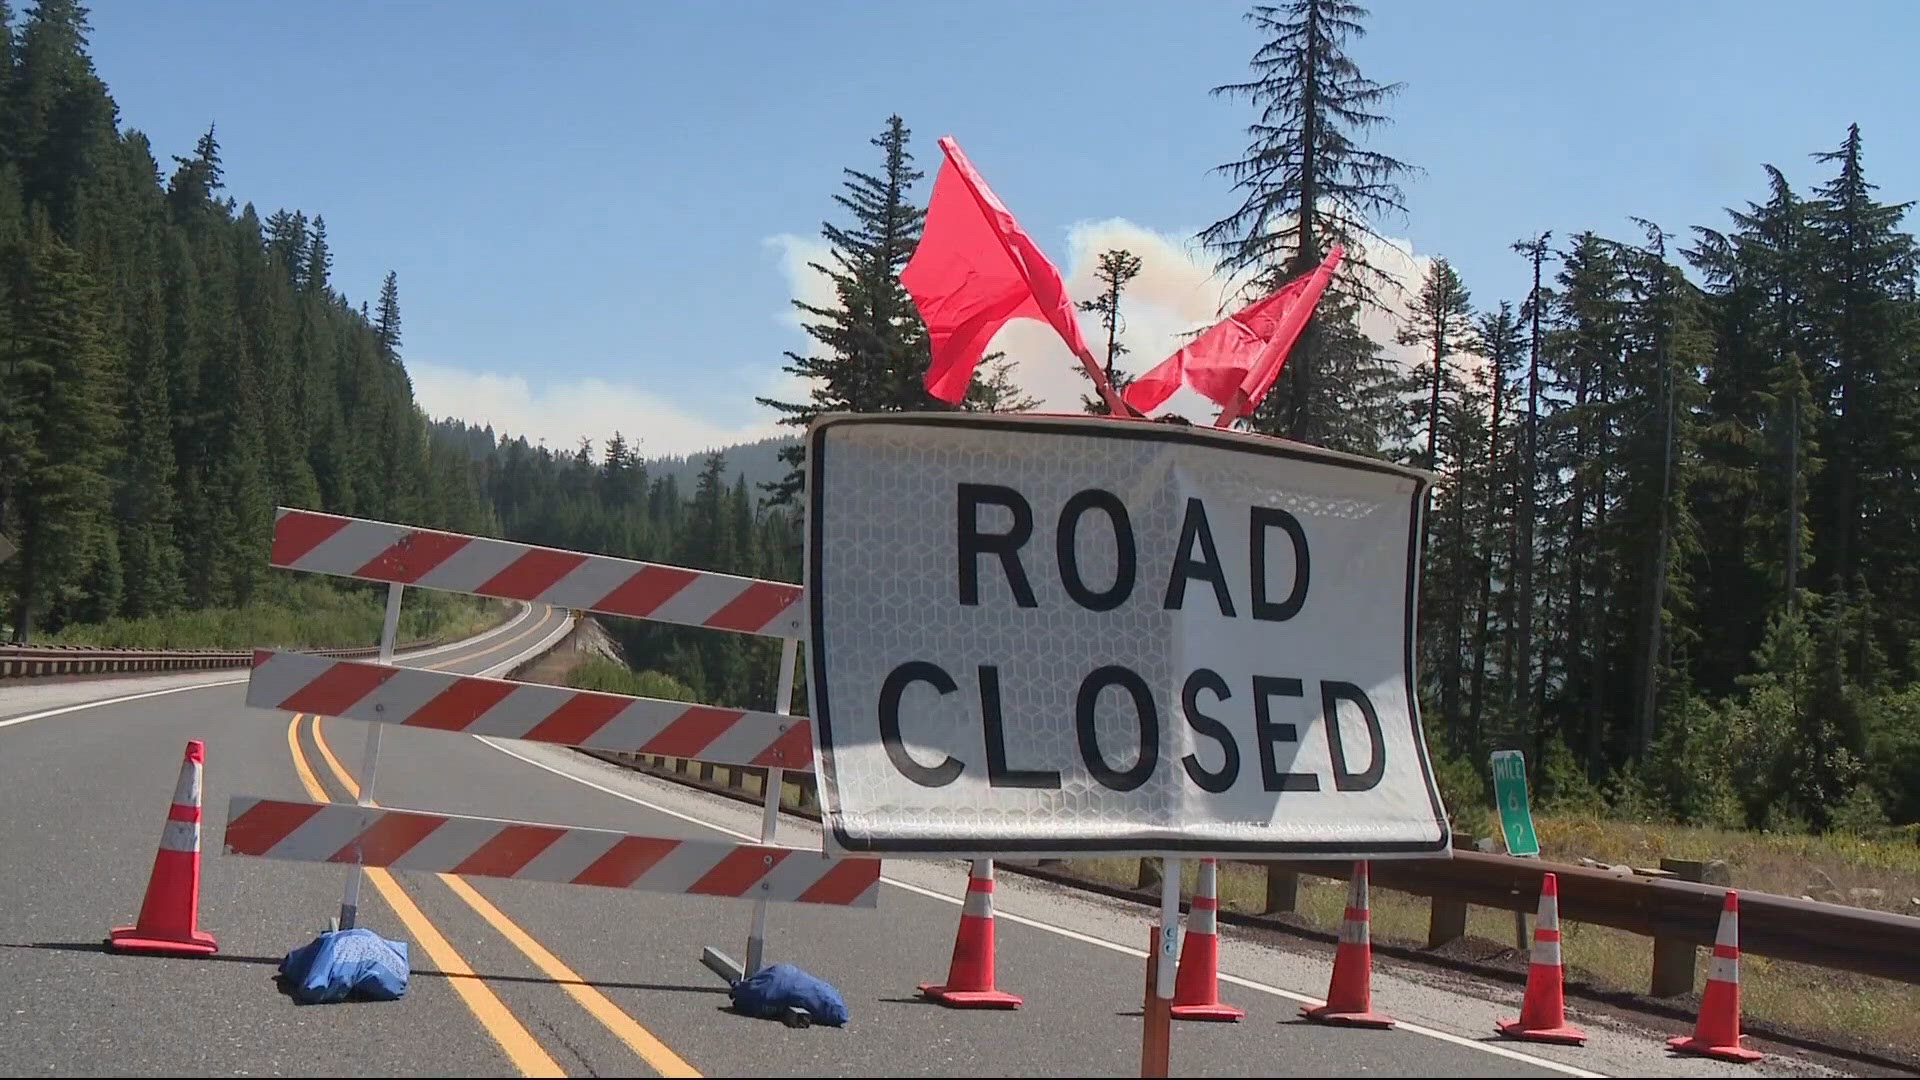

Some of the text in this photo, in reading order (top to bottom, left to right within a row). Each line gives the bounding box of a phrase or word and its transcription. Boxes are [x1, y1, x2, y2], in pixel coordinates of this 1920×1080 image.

[958, 482, 1311, 622] ROAD
[878, 661, 1386, 792] CLOSED
[1496, 759, 1522, 781] MILE
